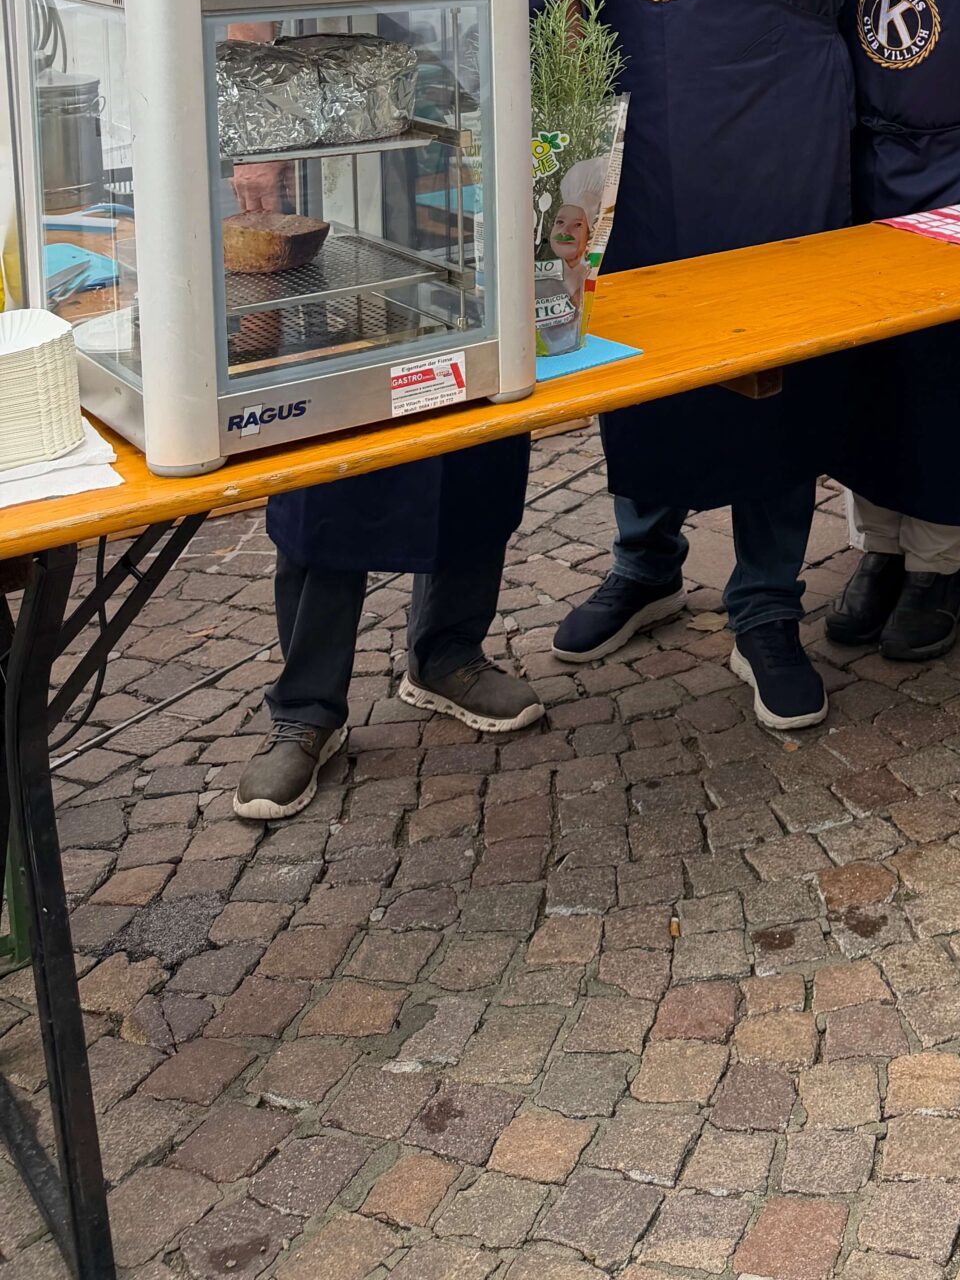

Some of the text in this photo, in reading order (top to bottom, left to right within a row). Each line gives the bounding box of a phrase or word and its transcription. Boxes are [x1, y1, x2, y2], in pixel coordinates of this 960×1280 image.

[863, 16, 930, 61] CLUB VILLACH
[536, 294, 569, 305] AGRICOLA
[392, 373, 423, 387] GASTRO
[227, 400, 307, 432] RAGUS
